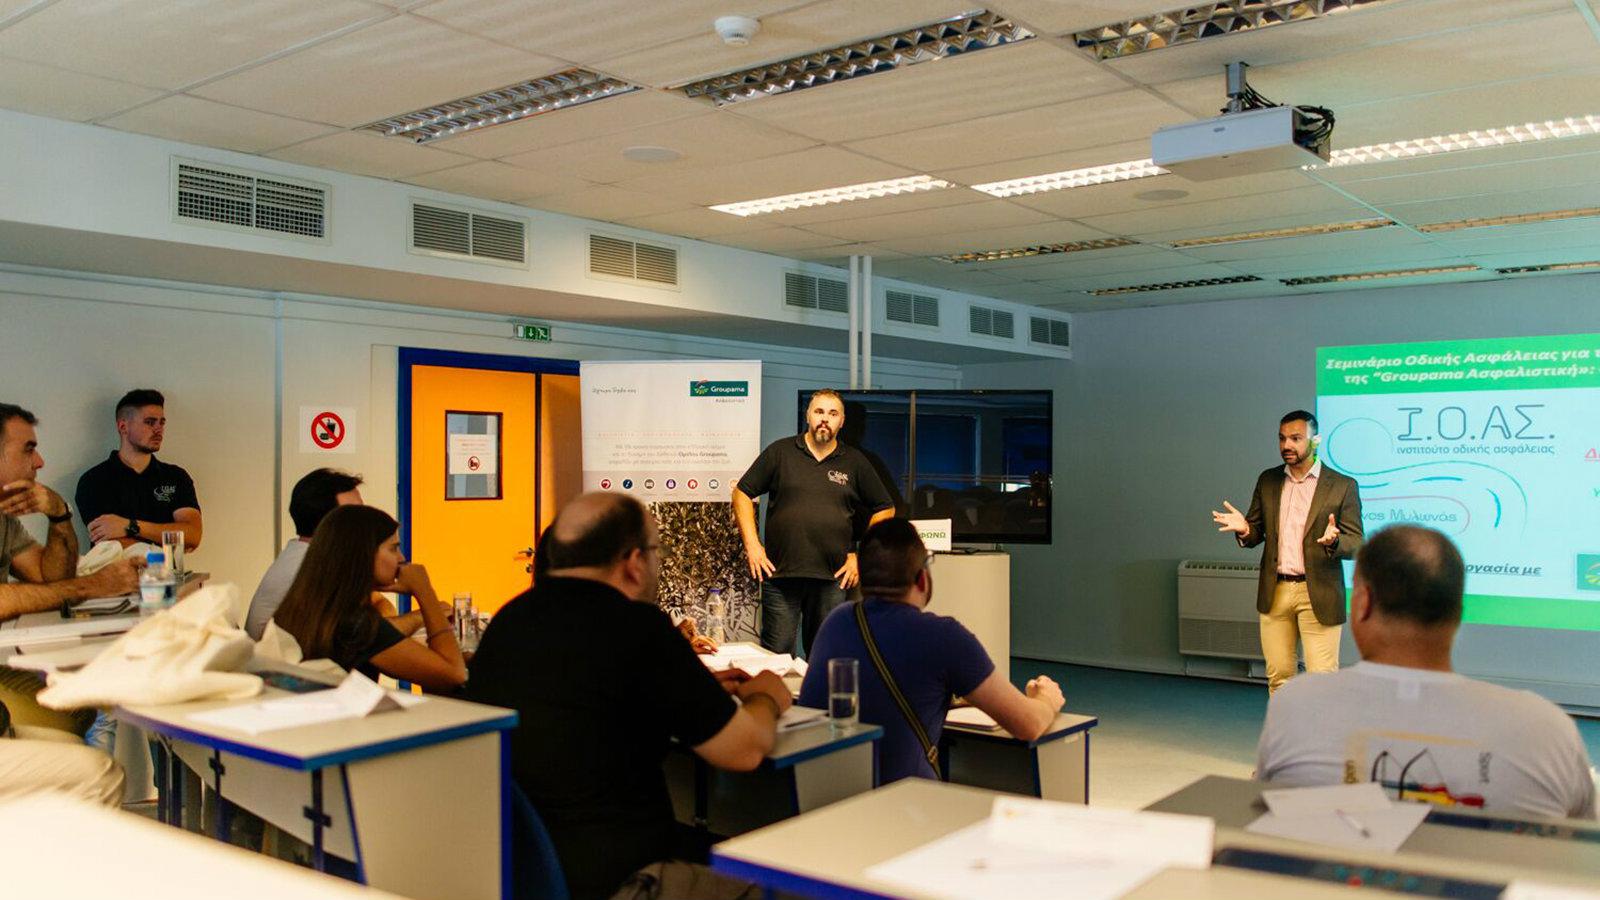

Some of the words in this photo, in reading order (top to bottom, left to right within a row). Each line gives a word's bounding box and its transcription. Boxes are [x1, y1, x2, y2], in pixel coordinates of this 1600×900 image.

[1326, 356, 1402, 371] Σεμινάριο
[1405, 353, 1460, 366] Οδικής
[1464, 350, 1559, 364] Ασφάλειας
[1562, 350, 1590, 361] για
[1344, 375, 1369, 385] της
[710, 385, 745, 394] Groupama
[1397, 445, 1450, 455] ινστιτούτο
[1453, 444, 1490, 455] οδικής
[1493, 443, 1556, 455] ασφάλειας
[1361, 512, 1385, 521] νος
[1465, 562, 1519, 575] ργασία
[1520, 565, 1542, 576] με
